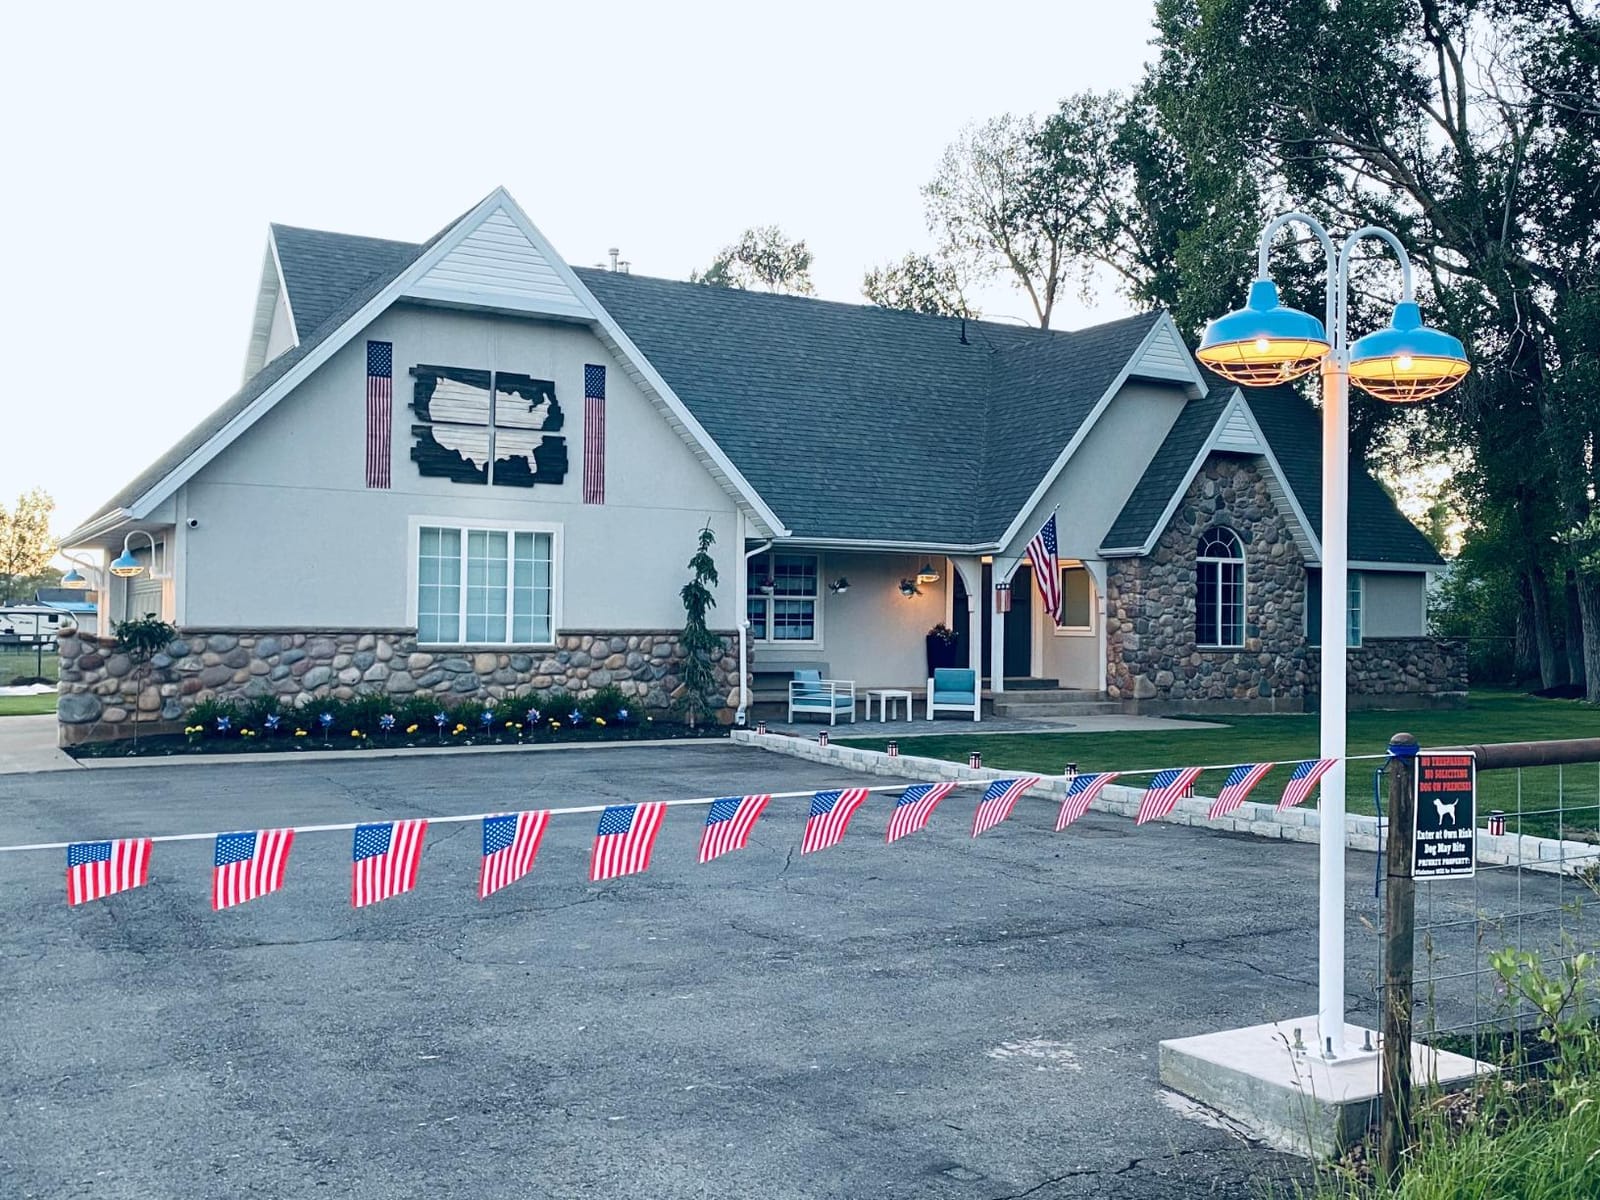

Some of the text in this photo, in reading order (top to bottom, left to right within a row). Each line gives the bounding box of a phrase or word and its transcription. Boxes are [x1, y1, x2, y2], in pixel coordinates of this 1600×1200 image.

[1417, 827, 1472, 840] Enter at Own Risk
[1424, 841, 1466, 856] Dog May Bite
